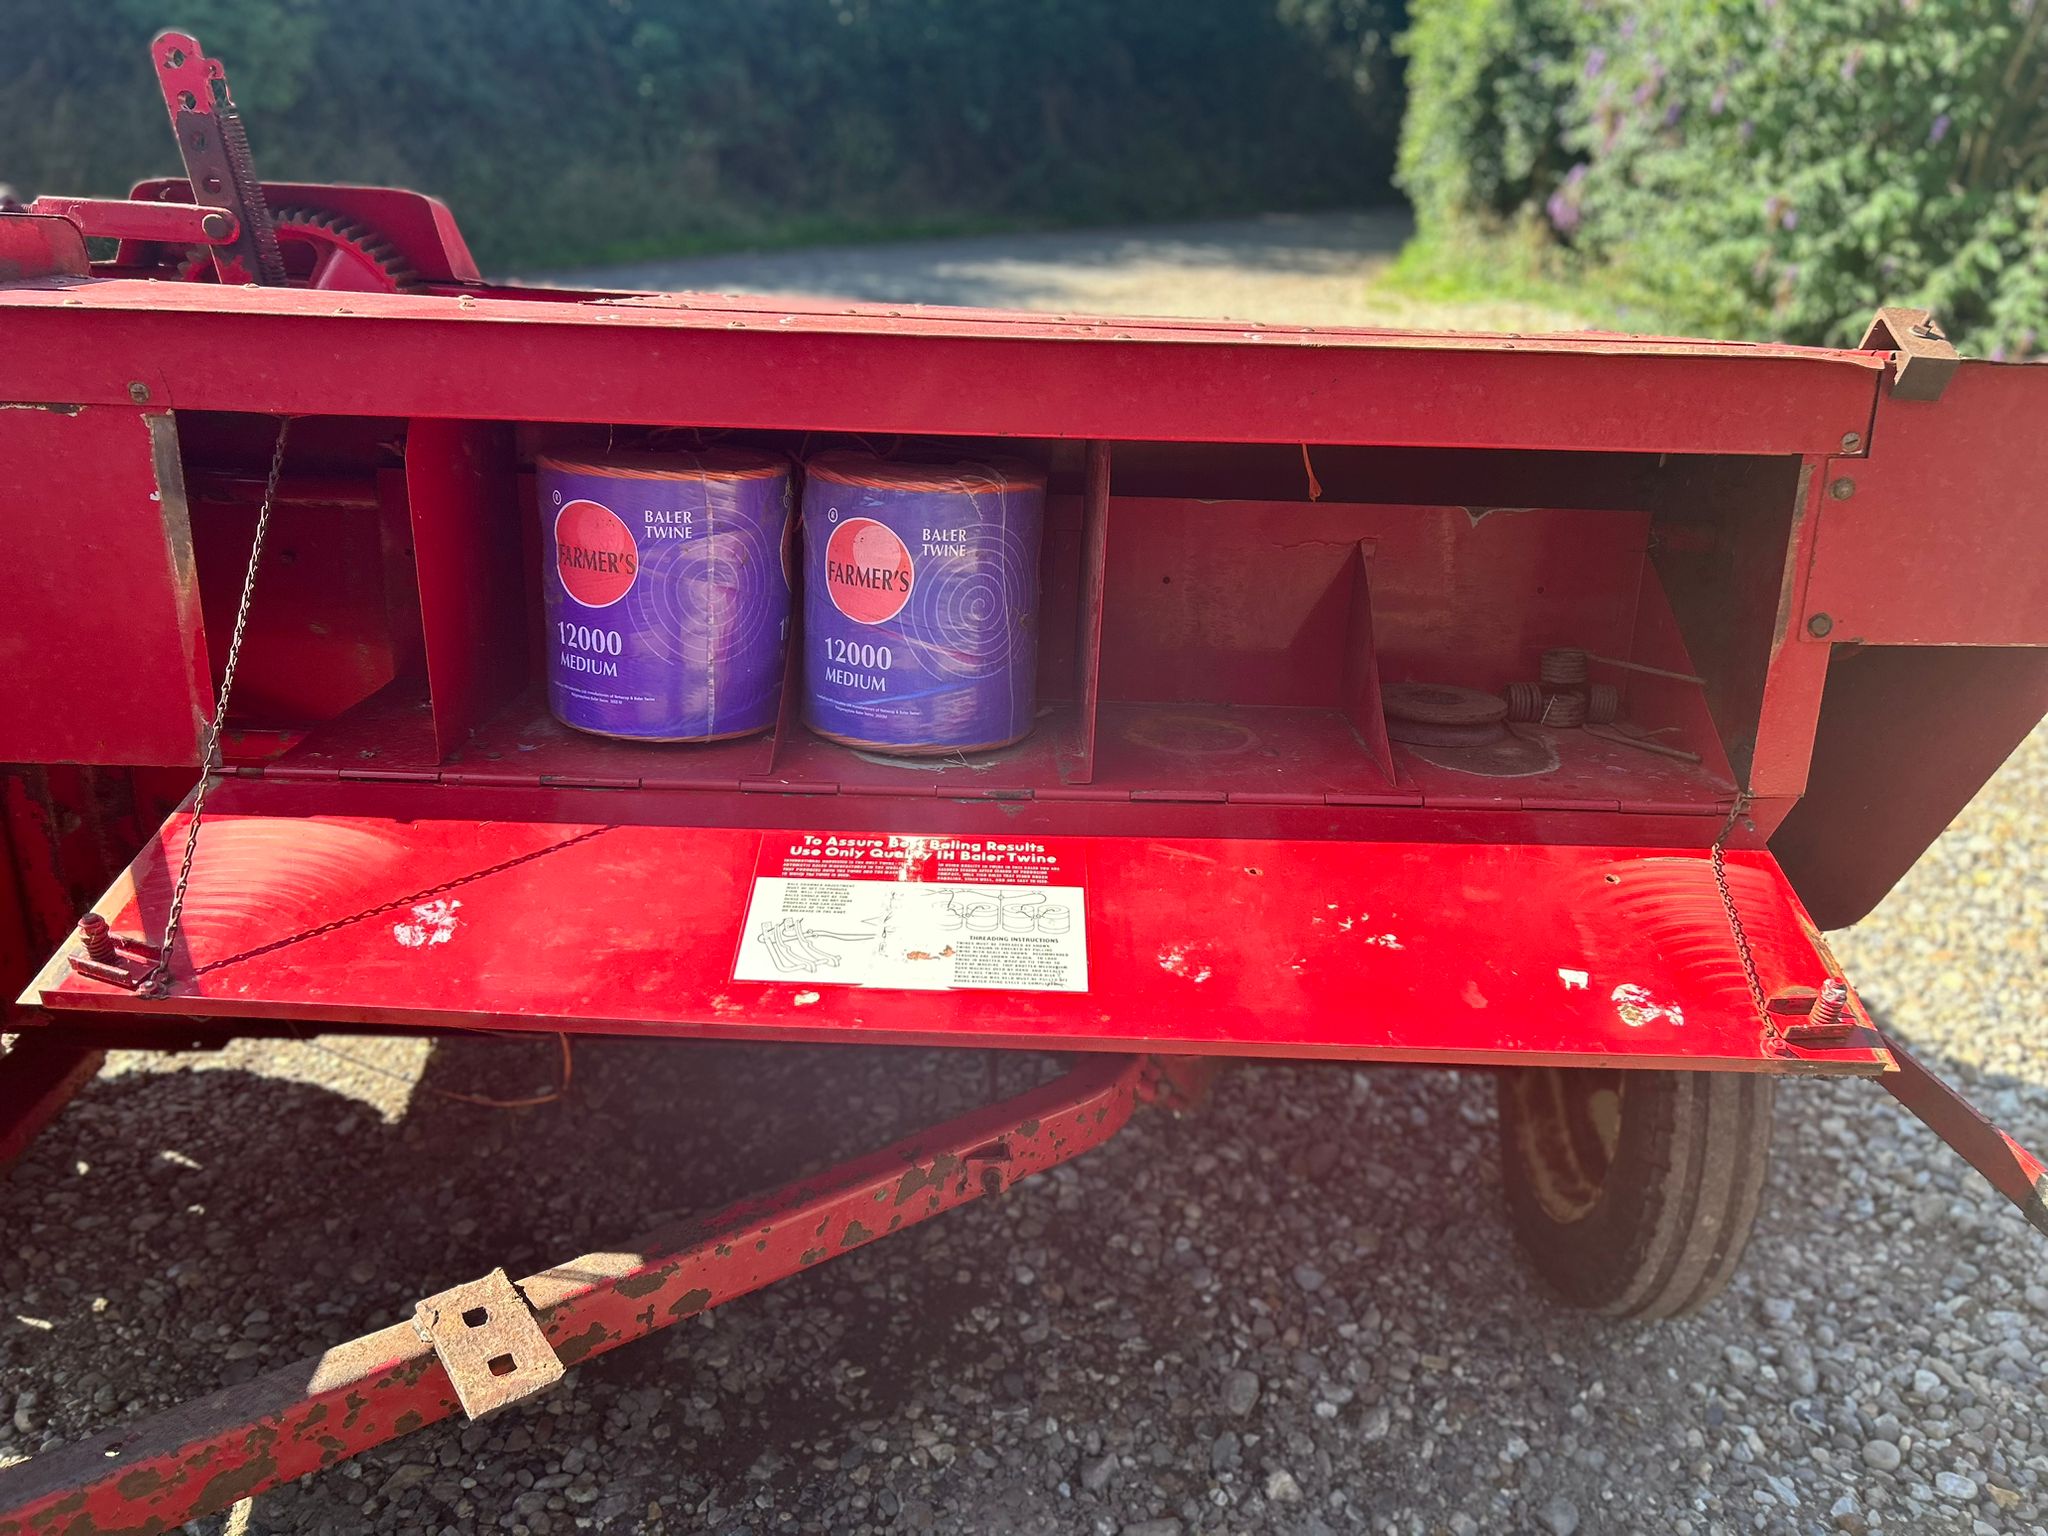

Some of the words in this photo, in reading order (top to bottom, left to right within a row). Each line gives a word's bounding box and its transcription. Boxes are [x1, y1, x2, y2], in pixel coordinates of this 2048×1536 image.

[645, 510, 693, 524] BALER
[645, 526, 693, 539] TWINE
[922, 528, 967, 542] BALER
[558, 543, 636, 575] FARMER'S
[922, 544, 966, 557] TWINE
[828, 561, 910, 592] FARMER'S
[557, 621, 623, 656] 12000
[824, 637, 892, 671] 12000
[560, 651, 618, 677] MEDIUM
[825, 666, 887, 692] MEDIUM
[804, 835, 822, 846] To
[826, 836, 884, 847] Assure
[930, 840, 982, 852] Baling
[986, 841, 1045, 853] Results
[790, 846, 822, 856] Use
[825, 847, 865, 859] Only
[937, 851, 955, 861] IH
[960, 851, 1005, 862] Baler
[1006, 852, 1057, 863] Twine
[1010, 936, 1059, 944] INSTRUCTIONS
